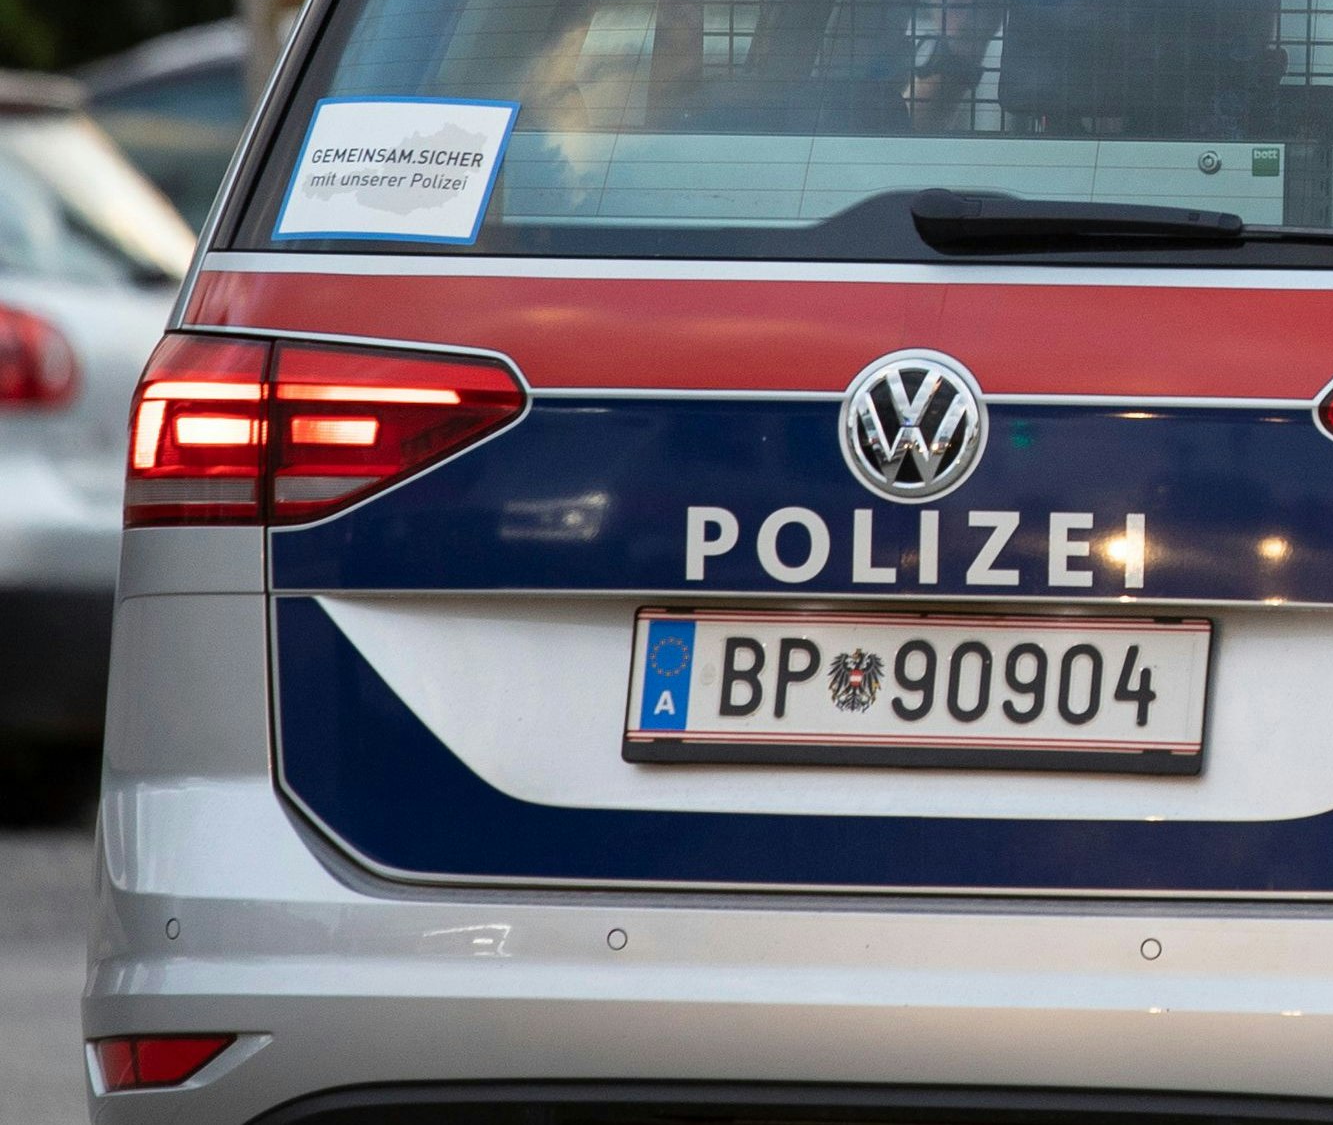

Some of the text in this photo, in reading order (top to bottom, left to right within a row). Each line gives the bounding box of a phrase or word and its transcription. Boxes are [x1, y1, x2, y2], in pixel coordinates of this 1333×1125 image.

[311, 147, 484, 168] GEMEINSAM.SICHER
[1253, 149, 1278, 160] bott
[310, 171, 468, 192] mit unserer Polizei
[685, 505, 1147, 589] POLIZEI
[718, 636, 1158, 727] BP 90904
[653, 691, 676, 716] A
